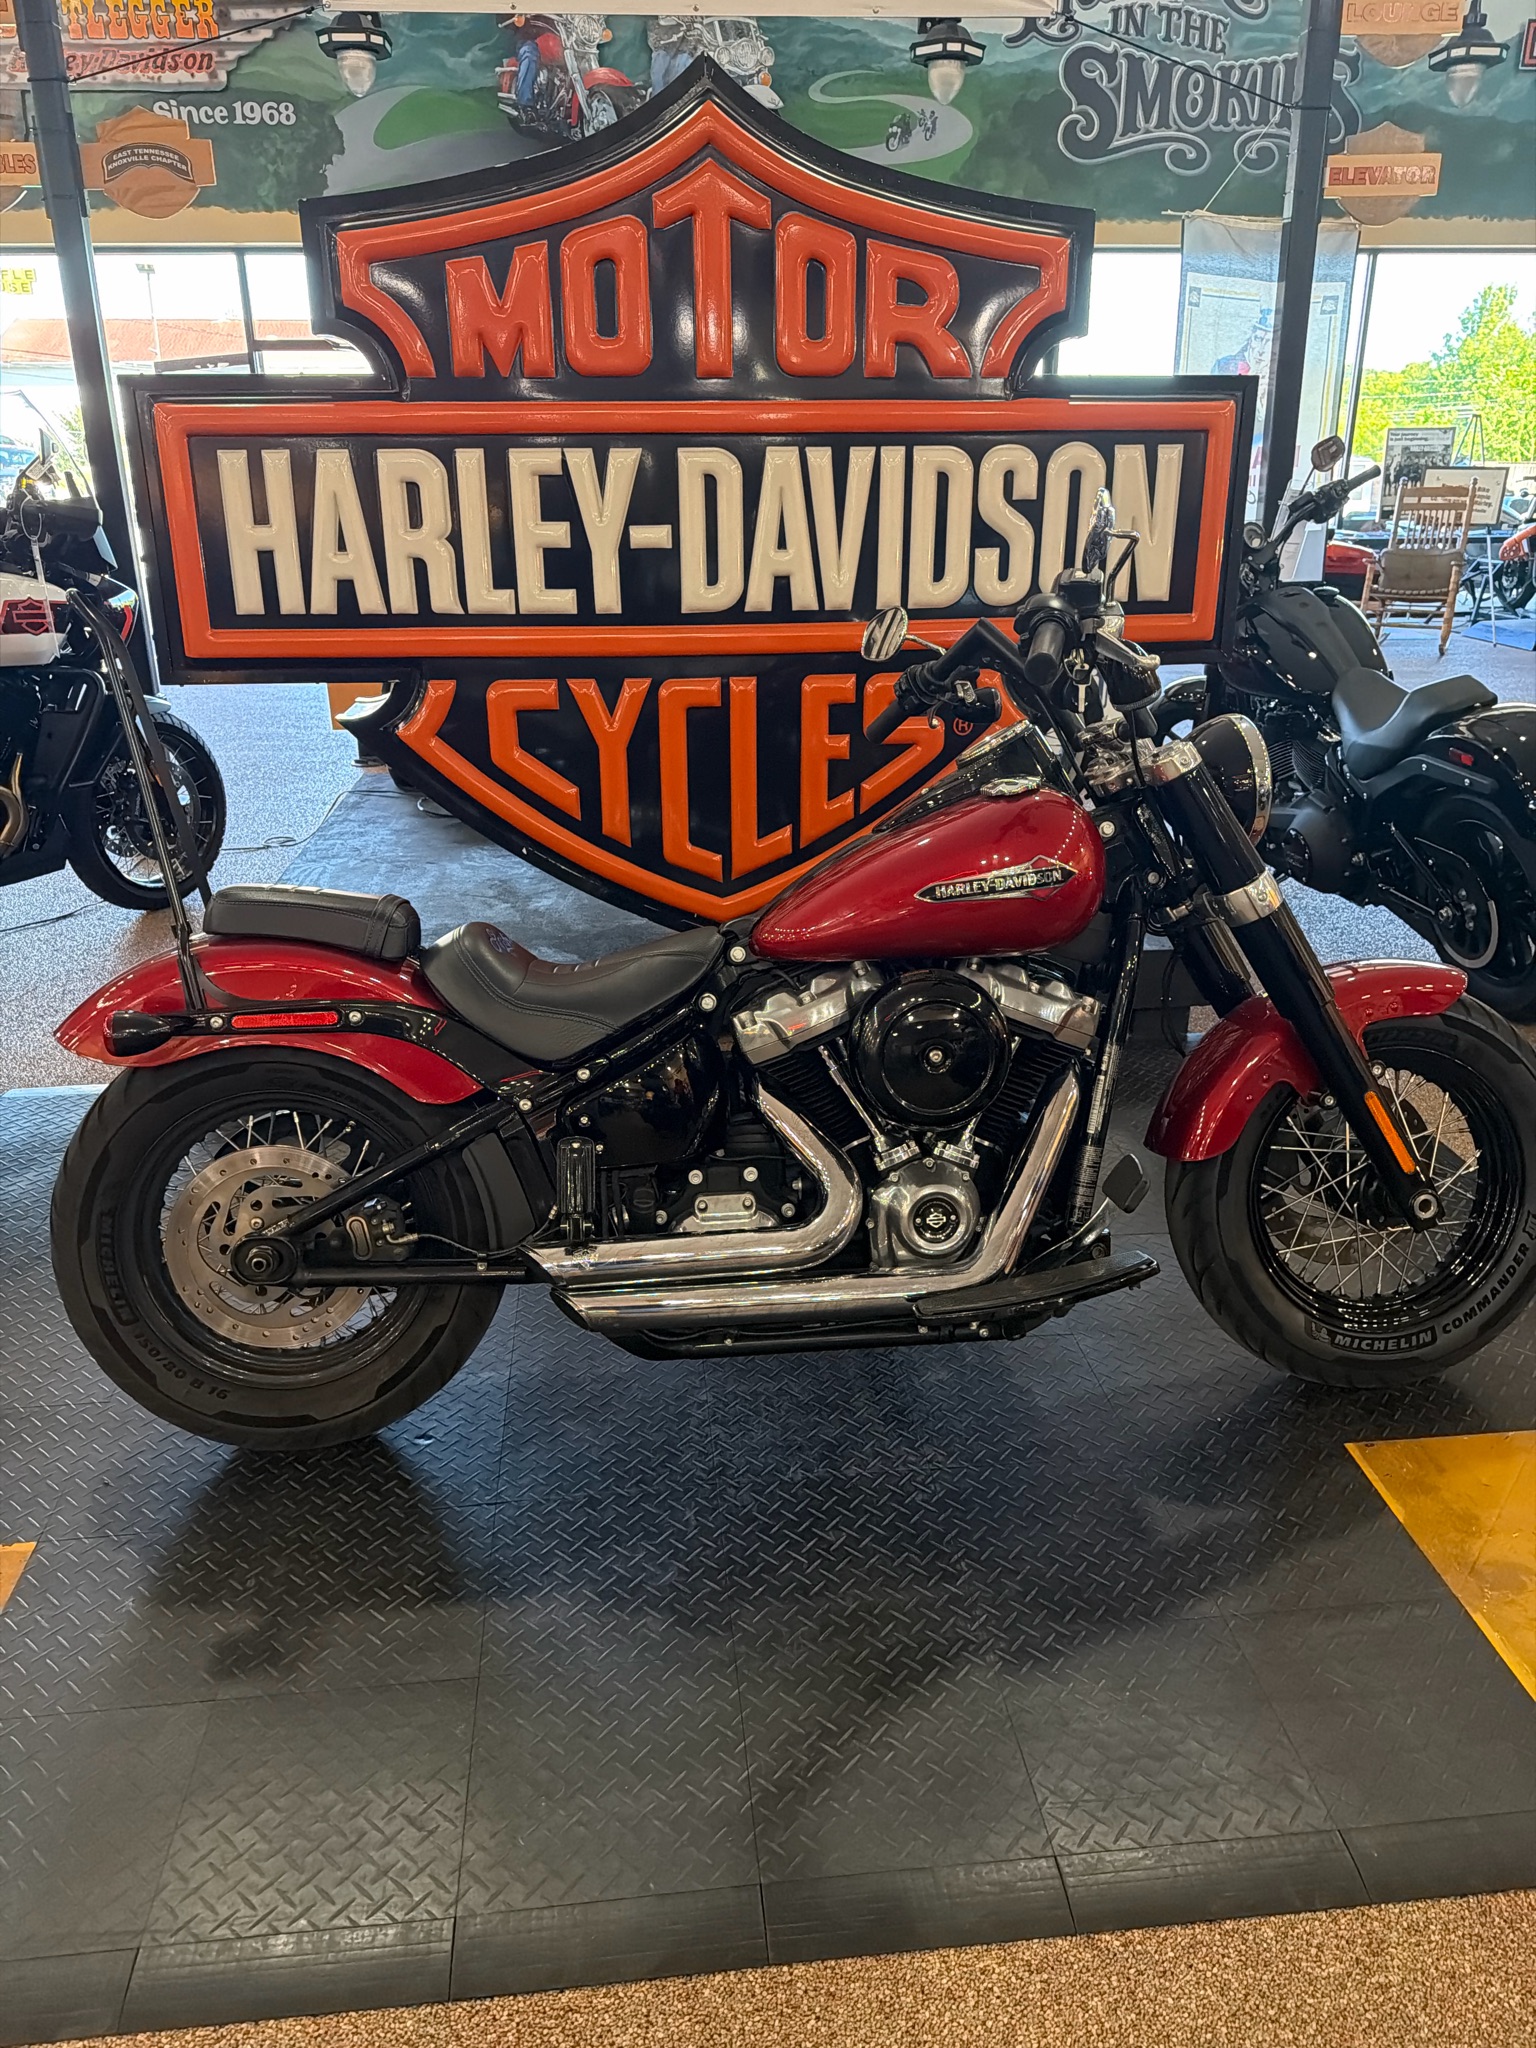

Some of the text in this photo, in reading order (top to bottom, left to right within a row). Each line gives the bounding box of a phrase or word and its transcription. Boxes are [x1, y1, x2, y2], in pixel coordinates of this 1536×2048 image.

[0, 0, 219, 39] TLEGGER
[1109, 3, 1151, 38] IN
[1157, 3, 1230, 55] THE
[232, 101, 296, 126] 1968
[107, 155, 188, 171] KNOXVILLE CHAPTER
[113, 148, 180, 161] EAST TENNESSEE
[1329, 166, 1436, 186] ELEVATOR
[444, 155, 971, 380] MOTOR
[216, 442, 1185, 616] HARLEY-DAVIDSON
[486, 676, 946, 882] CYCLES
[935, 869, 1063, 899] HARLEY-DAVIDSON
[1442, 1243, 1531, 1335] COMMANDER
[1334, 1331, 1433, 1351] MICHELIN
[208, 1386, 232, 1400] 16
